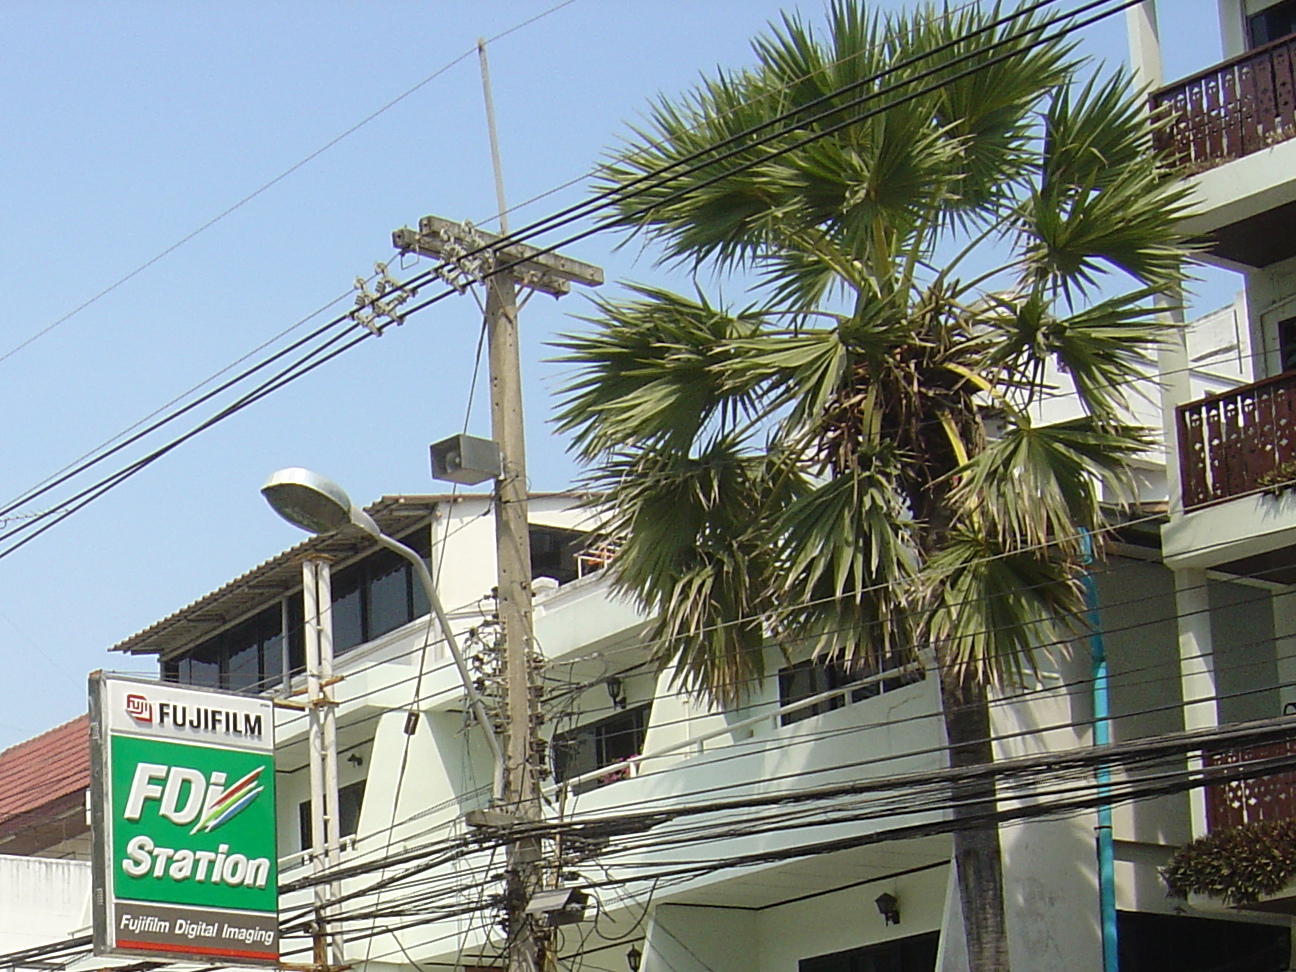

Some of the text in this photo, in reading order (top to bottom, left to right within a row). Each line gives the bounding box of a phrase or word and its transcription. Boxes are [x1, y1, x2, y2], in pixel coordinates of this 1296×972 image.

[159, 703, 262, 736] FUJIFILM
[120, 914, 274, 946] Fujifilm Digital Imaging
